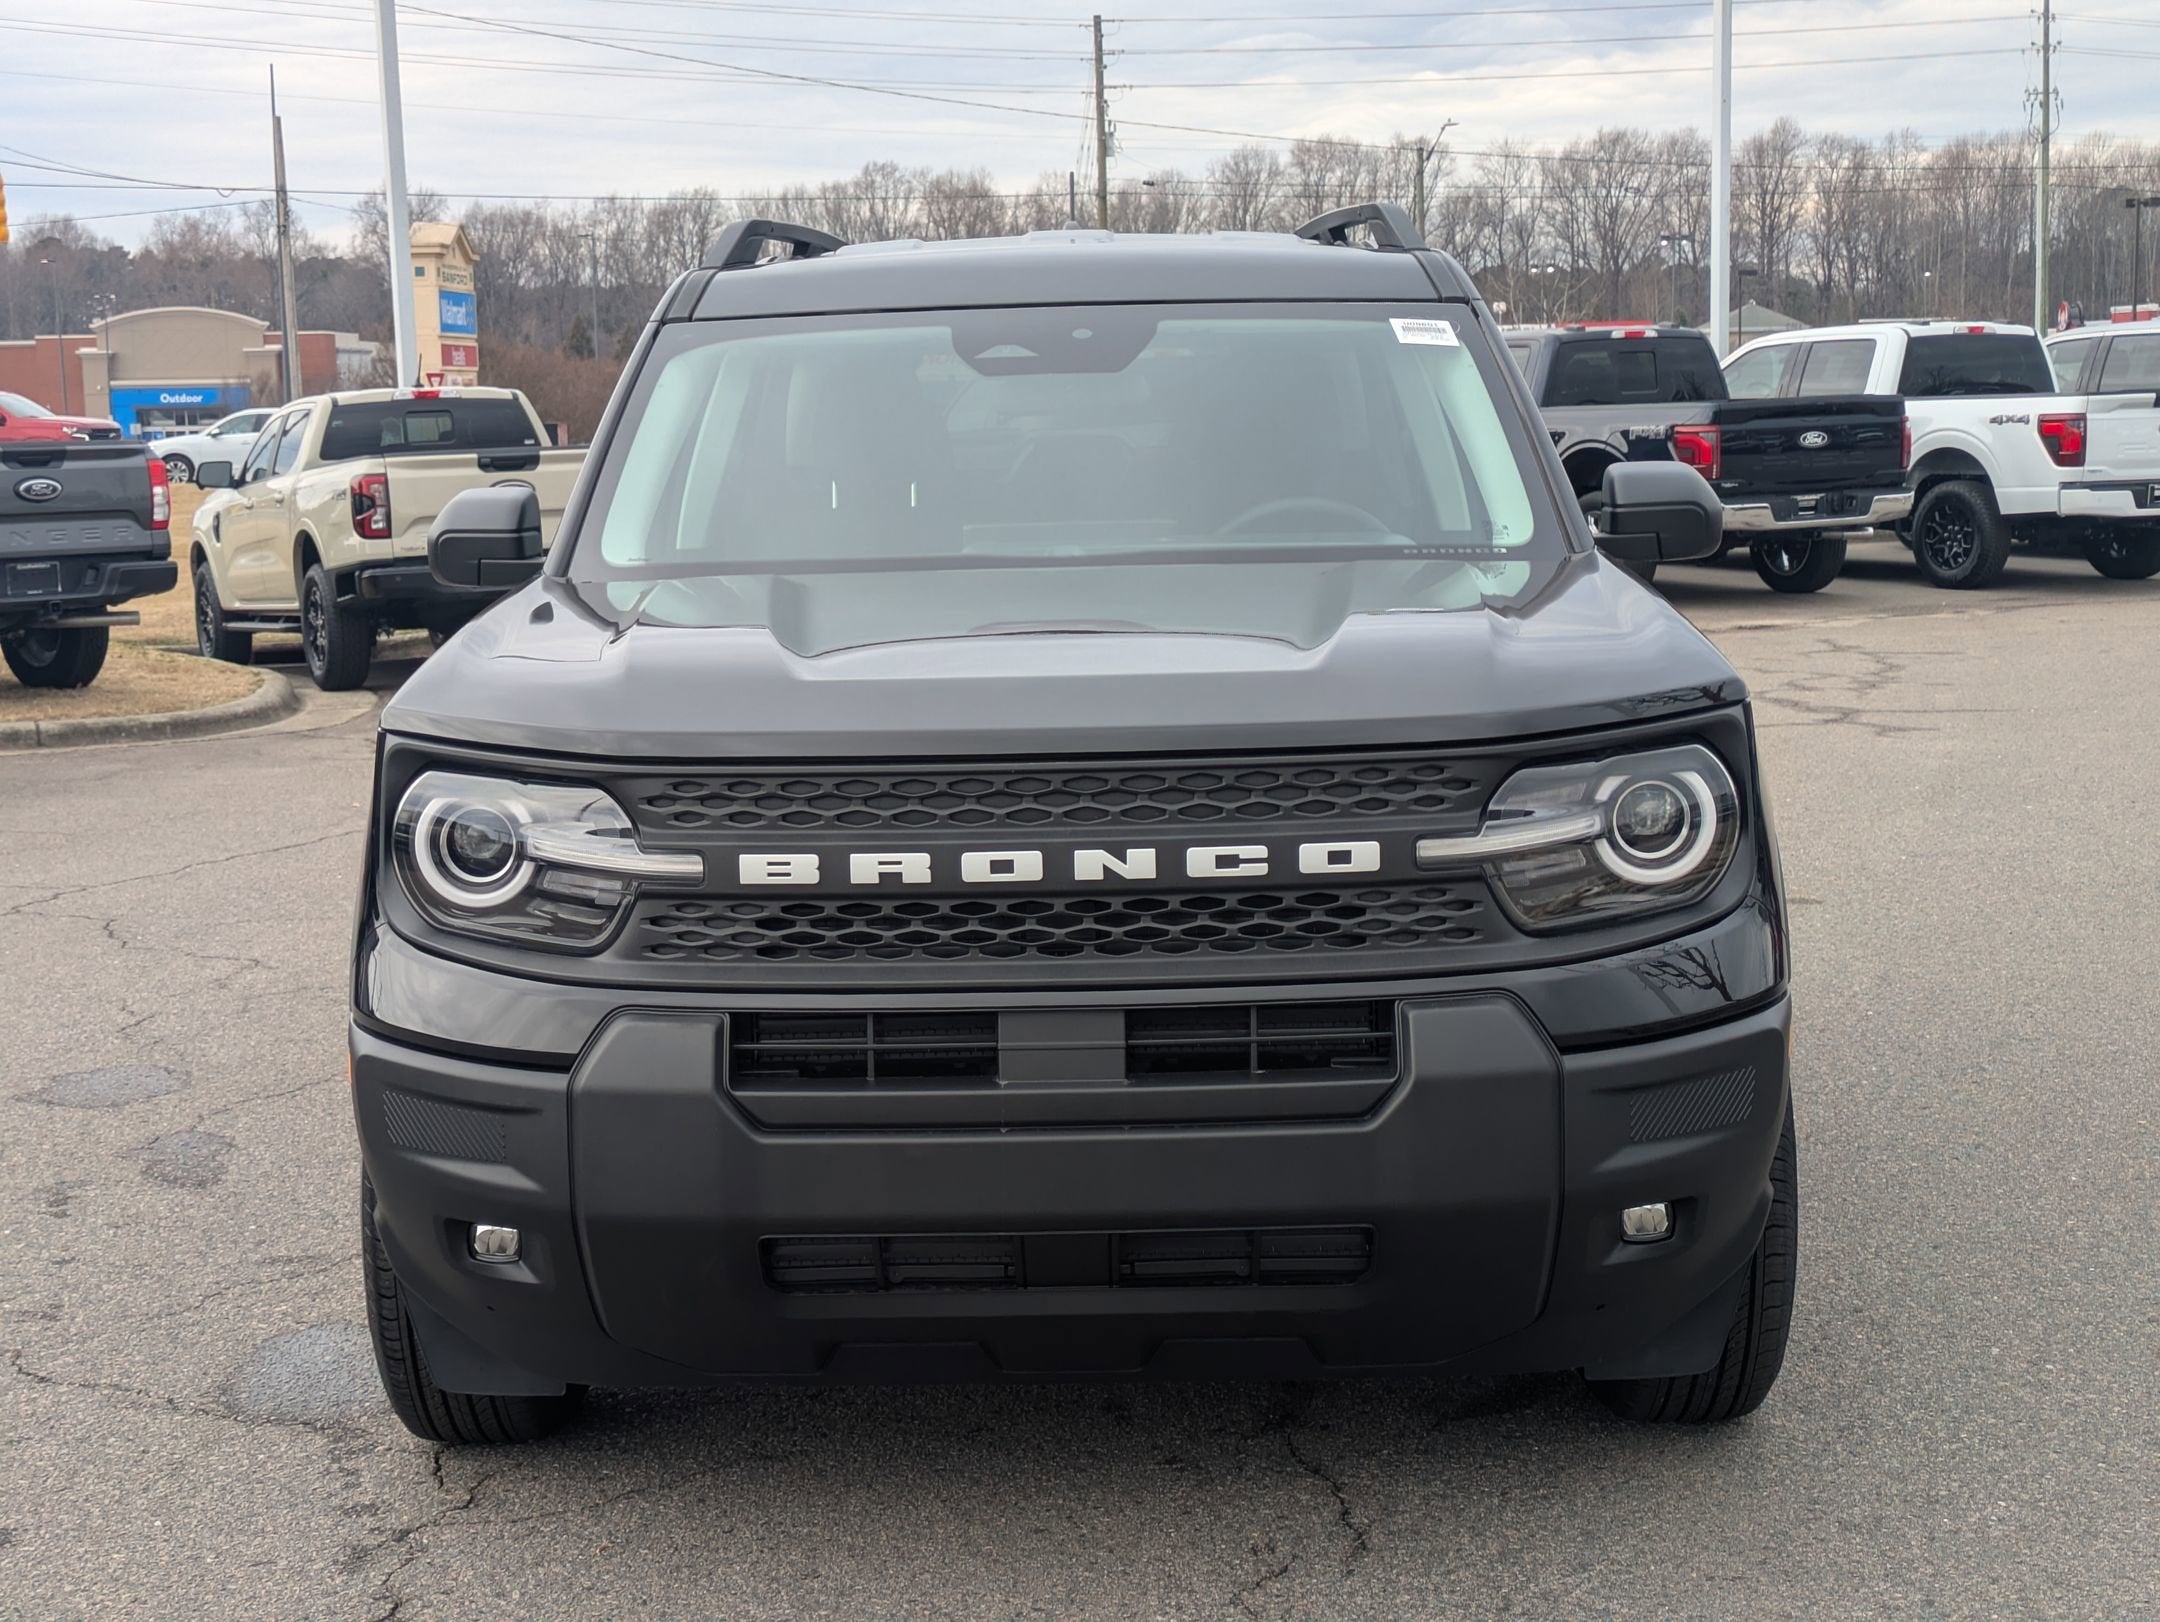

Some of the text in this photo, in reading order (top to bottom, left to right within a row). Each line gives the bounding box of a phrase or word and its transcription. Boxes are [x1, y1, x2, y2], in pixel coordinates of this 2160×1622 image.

[440, 298, 467, 326] Walmart
[160, 393, 203, 403] Outdoor
[1803, 432, 1824, 445] Ford
[738, 841, 1381, 885] BRONCO
